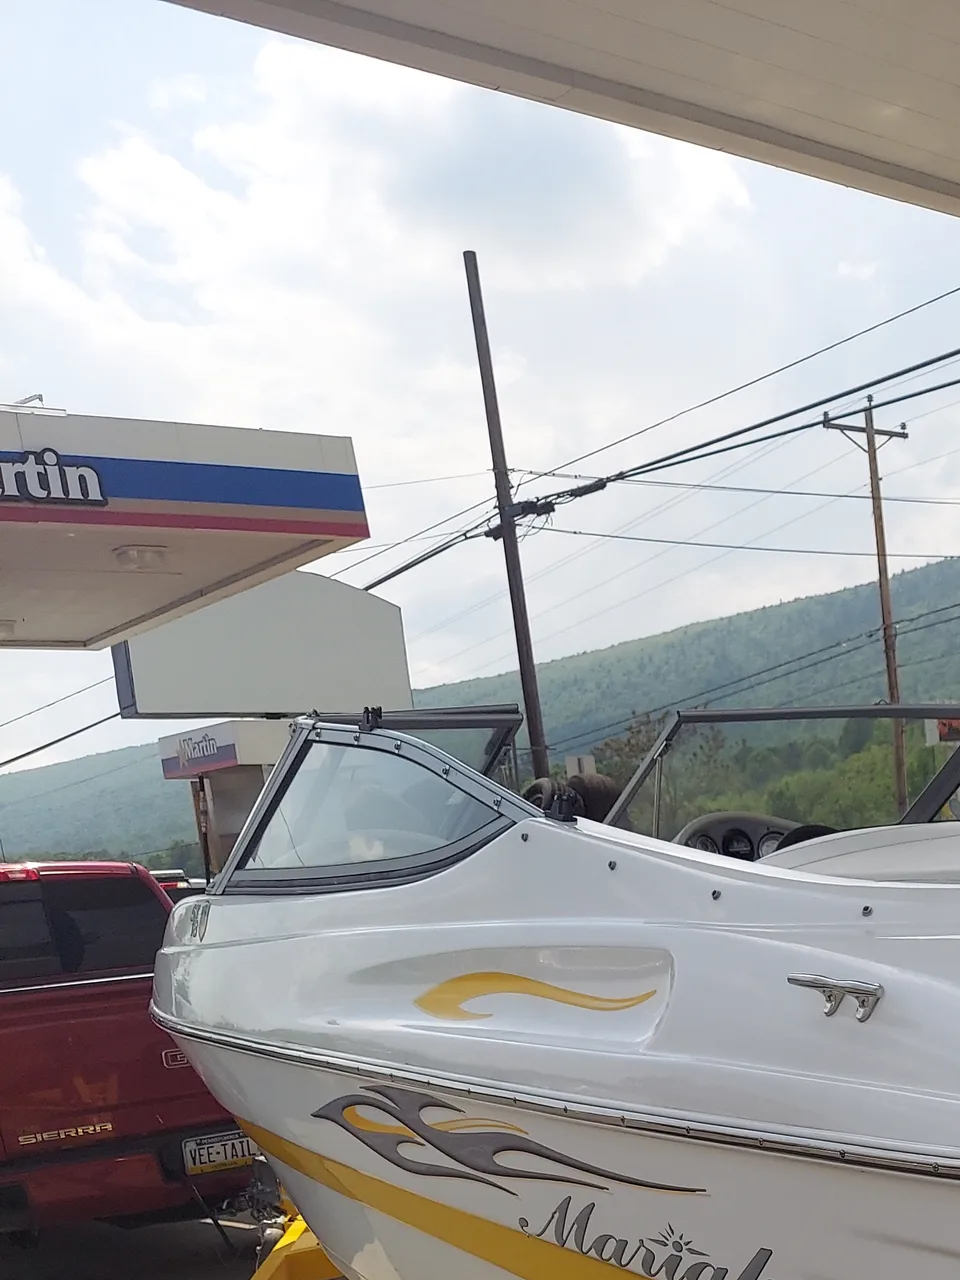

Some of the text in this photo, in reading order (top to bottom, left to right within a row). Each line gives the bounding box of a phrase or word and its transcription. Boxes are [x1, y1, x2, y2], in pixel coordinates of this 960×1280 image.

[0, 449, 107, 503] rtin
[182, 733, 218, 759] Martin
[17, 1122, 114, 1146] SIERRA
